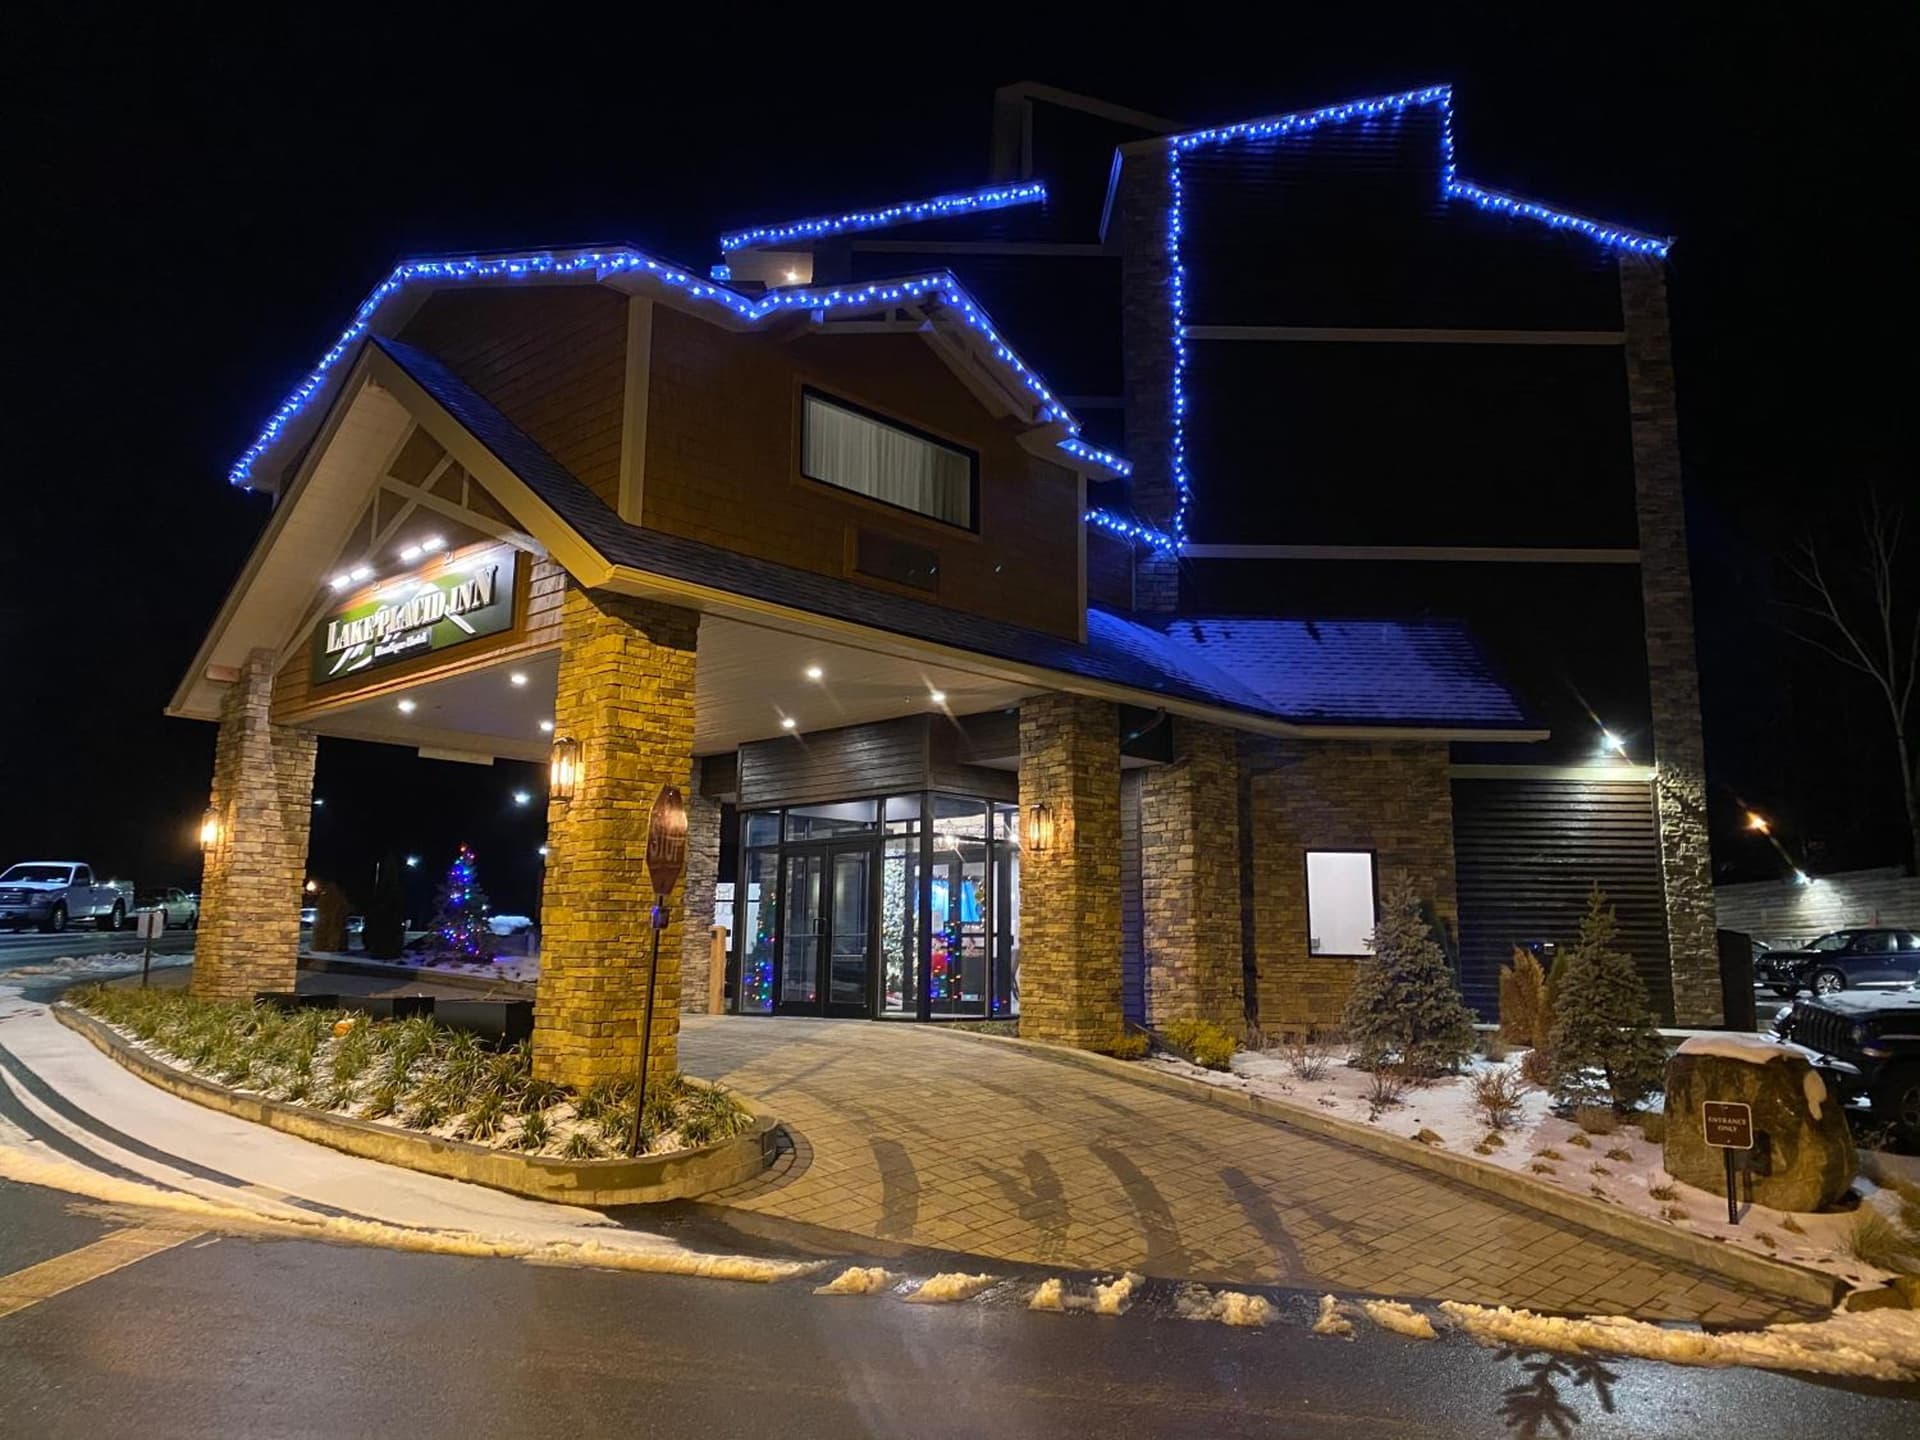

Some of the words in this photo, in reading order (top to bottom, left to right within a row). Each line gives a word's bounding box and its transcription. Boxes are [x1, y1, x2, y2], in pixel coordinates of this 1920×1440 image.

[326, 615, 374, 654] LAKE
[373, 591, 446, 637] PLACID
[448, 564, 498, 615] INN
[1707, 1116, 1747, 1126] ENTRANCE
[1717, 1125, 1738, 1133] ONLY
